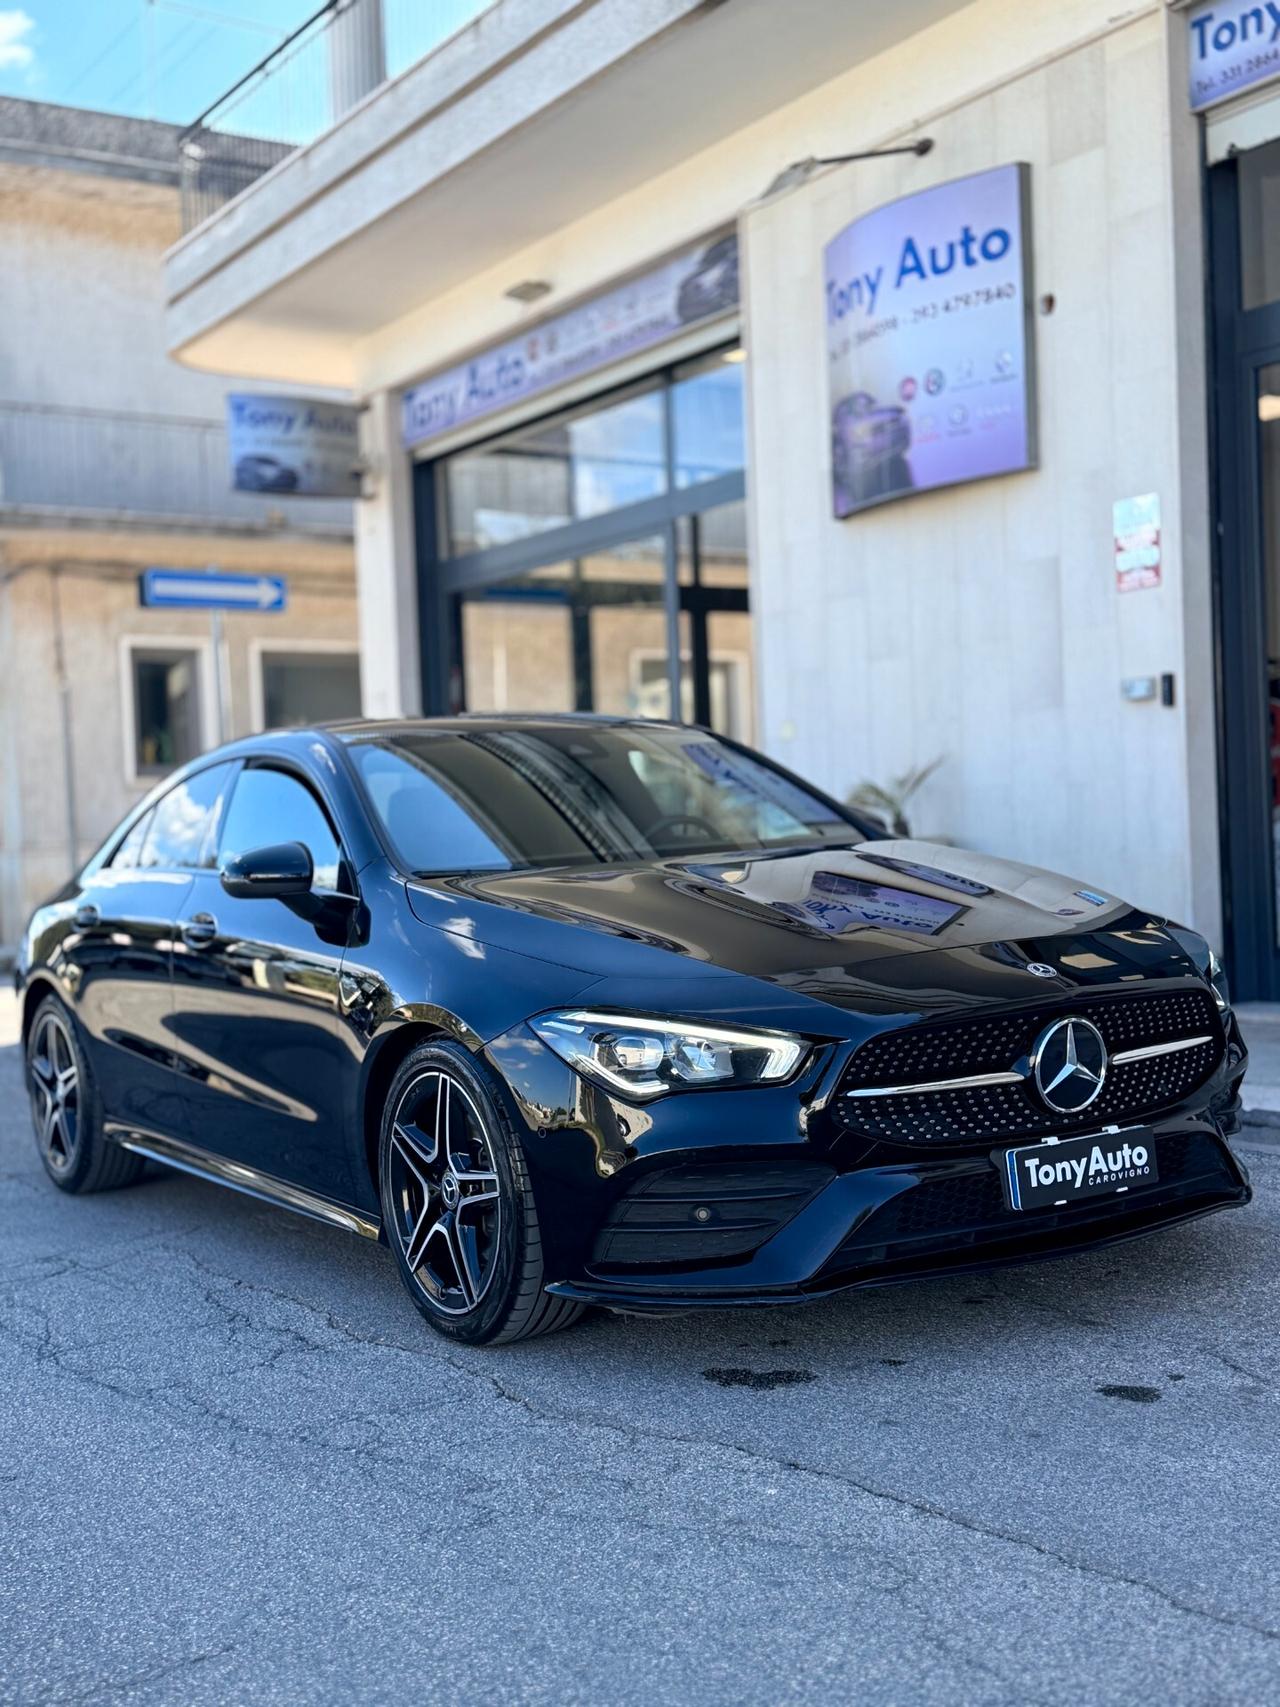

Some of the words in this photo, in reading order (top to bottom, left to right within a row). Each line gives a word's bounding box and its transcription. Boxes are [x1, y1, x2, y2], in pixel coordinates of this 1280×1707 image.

[895, 225, 1012, 289] Auto
[465, 357, 524, 401] Auto
[1024, 1143, 1149, 1188] TonyAuto
[1088, 1166, 1150, 1186] CAROVIGNO
